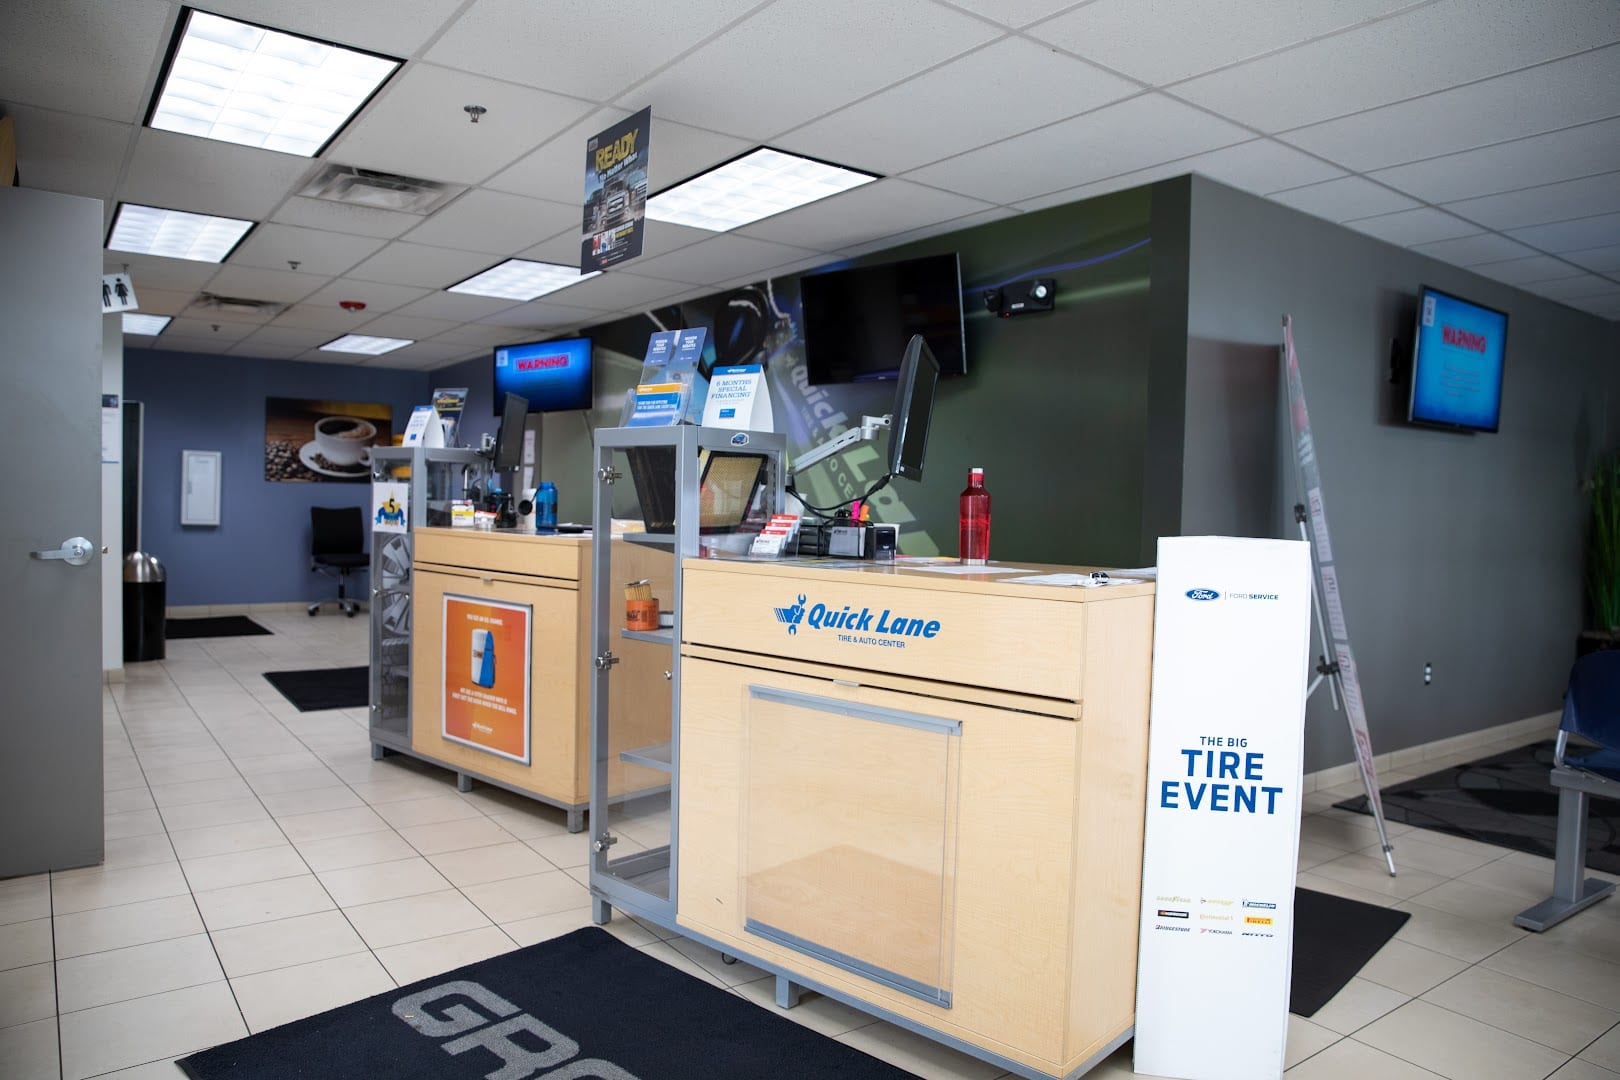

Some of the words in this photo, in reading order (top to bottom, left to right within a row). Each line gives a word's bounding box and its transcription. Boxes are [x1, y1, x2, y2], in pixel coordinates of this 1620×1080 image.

[595, 128, 639, 172] READY
[1442, 325, 1487, 355] WARNING
[516, 355, 568, 372] WARNING
[1190, 589, 1216, 601] Ford
[1248, 593, 1279, 601] SERVICE
[807, 603, 874, 632] Quick
[875, 609, 941, 639] Lane
[838, 634, 852, 643] TIRE
[859, 637, 877, 646] AUTO
[878, 638, 906, 649] CENTER
[1200, 736, 1223, 747] THE
[1227, 737, 1248, 748] BIG
[1181, 749, 1264, 781] TIRE
[1160, 780, 1284, 815] EVENT
